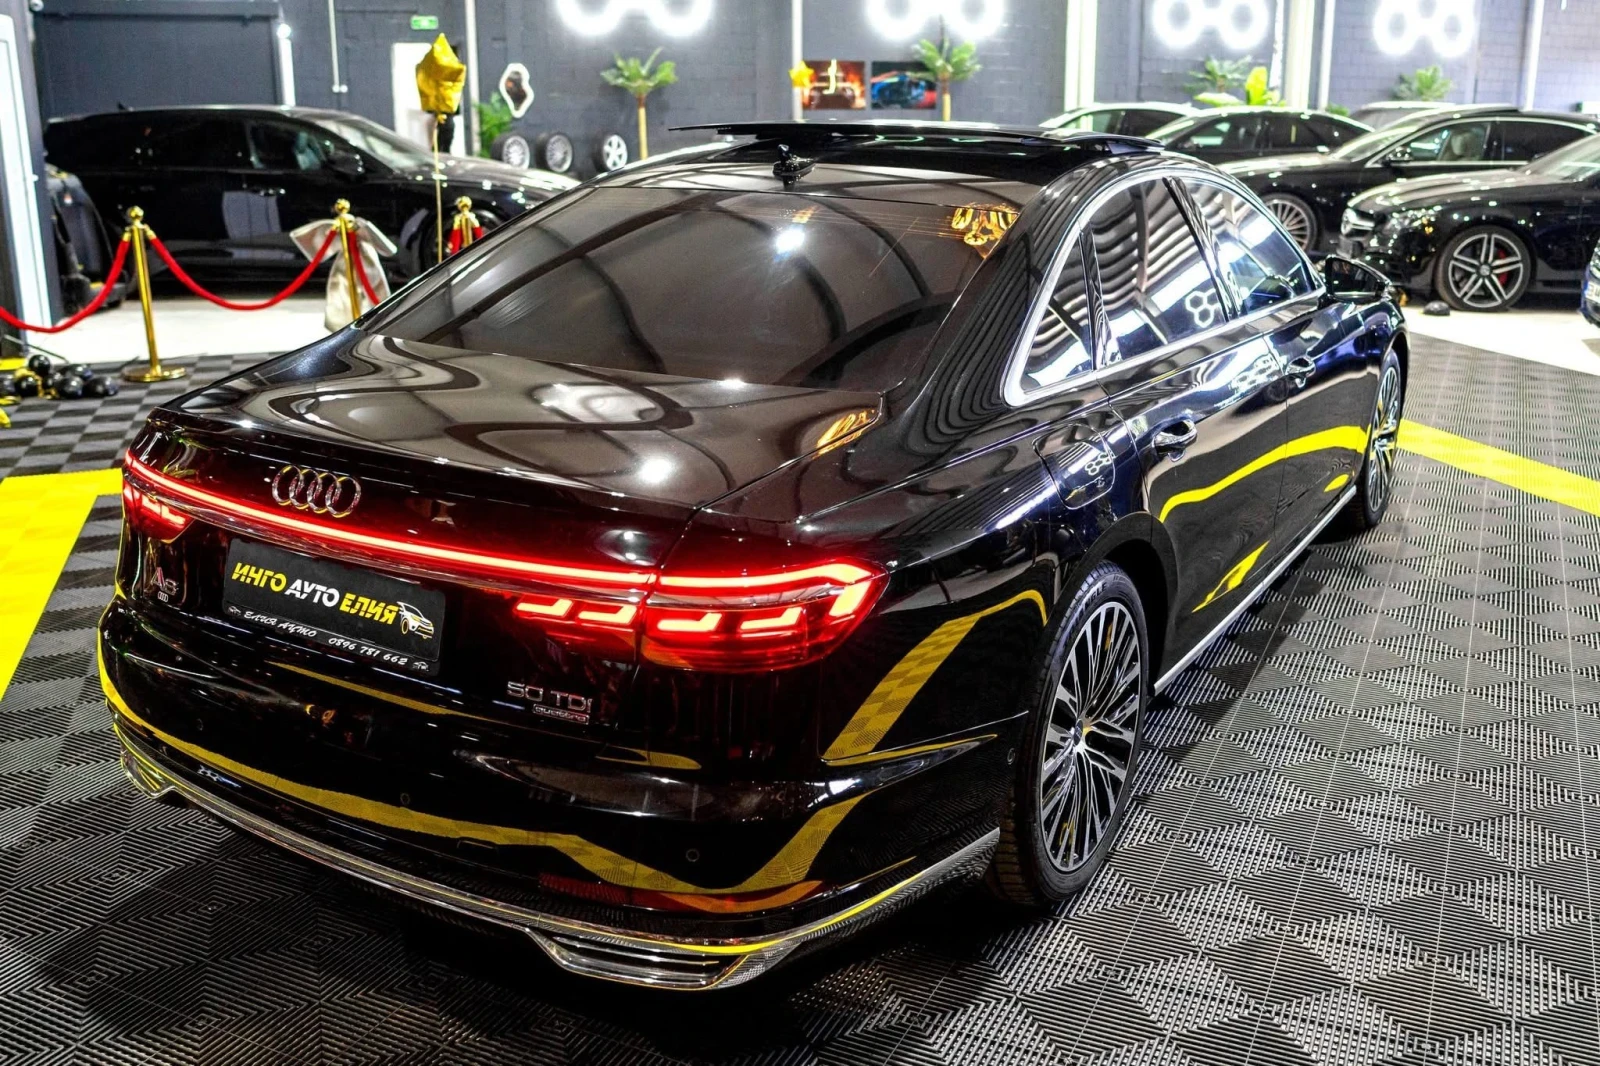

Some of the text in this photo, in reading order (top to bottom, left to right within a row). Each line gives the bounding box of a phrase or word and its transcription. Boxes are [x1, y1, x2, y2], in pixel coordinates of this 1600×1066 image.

[150, 567, 176, 595] A8
[231, 562, 400, 625] ИНГО АУТО ЕЛИЯ
[328, 638, 357, 650] 0896
[360, 646, 380, 656] 781
[383, 654, 408, 665] 662
[507, 681, 593, 713] 50 TDI
